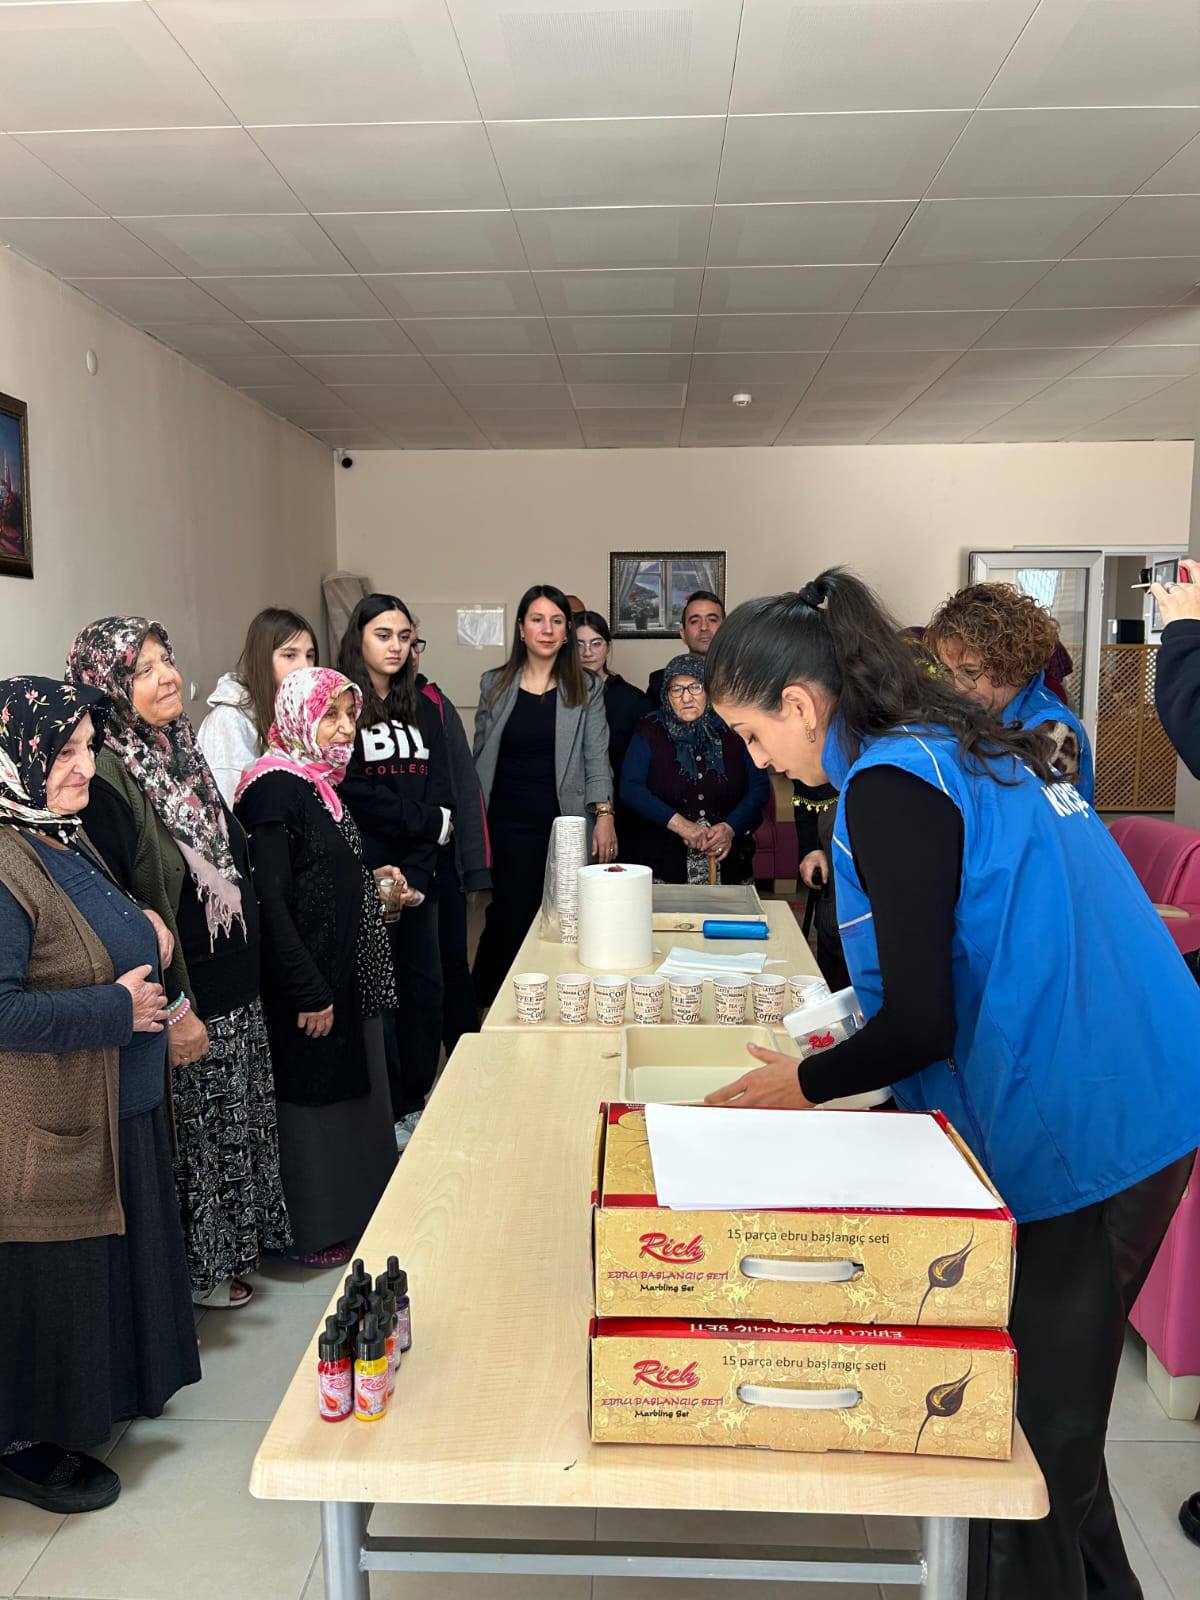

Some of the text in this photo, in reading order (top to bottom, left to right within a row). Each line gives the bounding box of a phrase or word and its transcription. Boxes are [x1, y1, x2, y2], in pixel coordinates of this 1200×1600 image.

[727, 1229, 889, 1245] 15 parça ebru başlangıç seti
[639, 1232, 705, 1264] Rich
[639, 1284, 695, 1293] Marbling Set
[722, 1355, 887, 1371] 15 parça ebru başlangıç seti
[633, 1360, 701, 1391] Rich
[634, 1409, 690, 1418] Marbling Set
